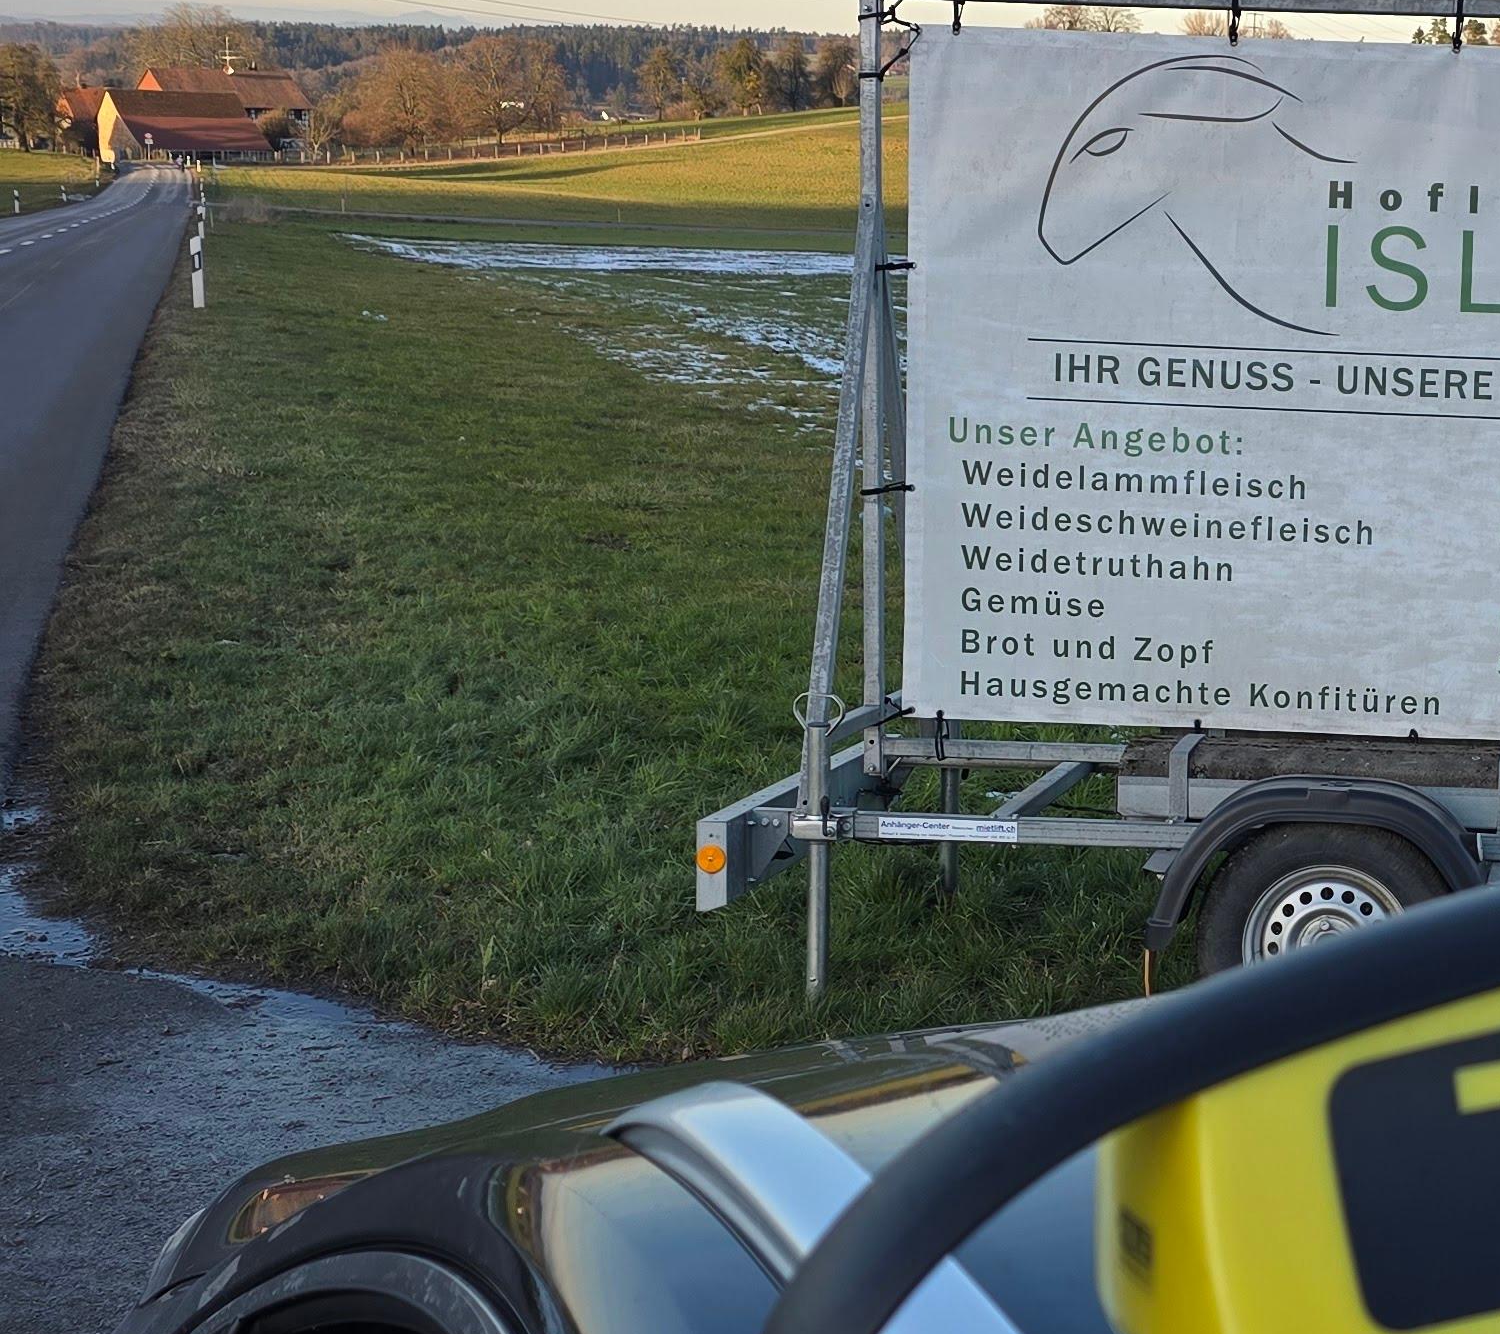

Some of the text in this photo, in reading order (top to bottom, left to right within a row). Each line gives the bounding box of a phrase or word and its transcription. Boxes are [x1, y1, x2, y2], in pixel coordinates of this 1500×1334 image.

[1055, 353, 1119, 384] IHR
[1138, 357, 1293, 392] GENUSS
[1338, 365, 1493, 400] UNSERE
[950, 417, 1242, 457] Unser Angebot:
[962, 460, 1305, 499] Weidelammfleisch
[961, 503, 1372, 545] Weideschweinefleisch
[961, 545, 1232, 581] Weidetruthahn
[962, 587, 1104, 618] Gemüse
[962, 629, 1213, 668] Brot und Zopf
[961, 671, 1439, 715] Hausgemachte Konfitüren
[880, 820, 950, 830] Anhänger-Center
